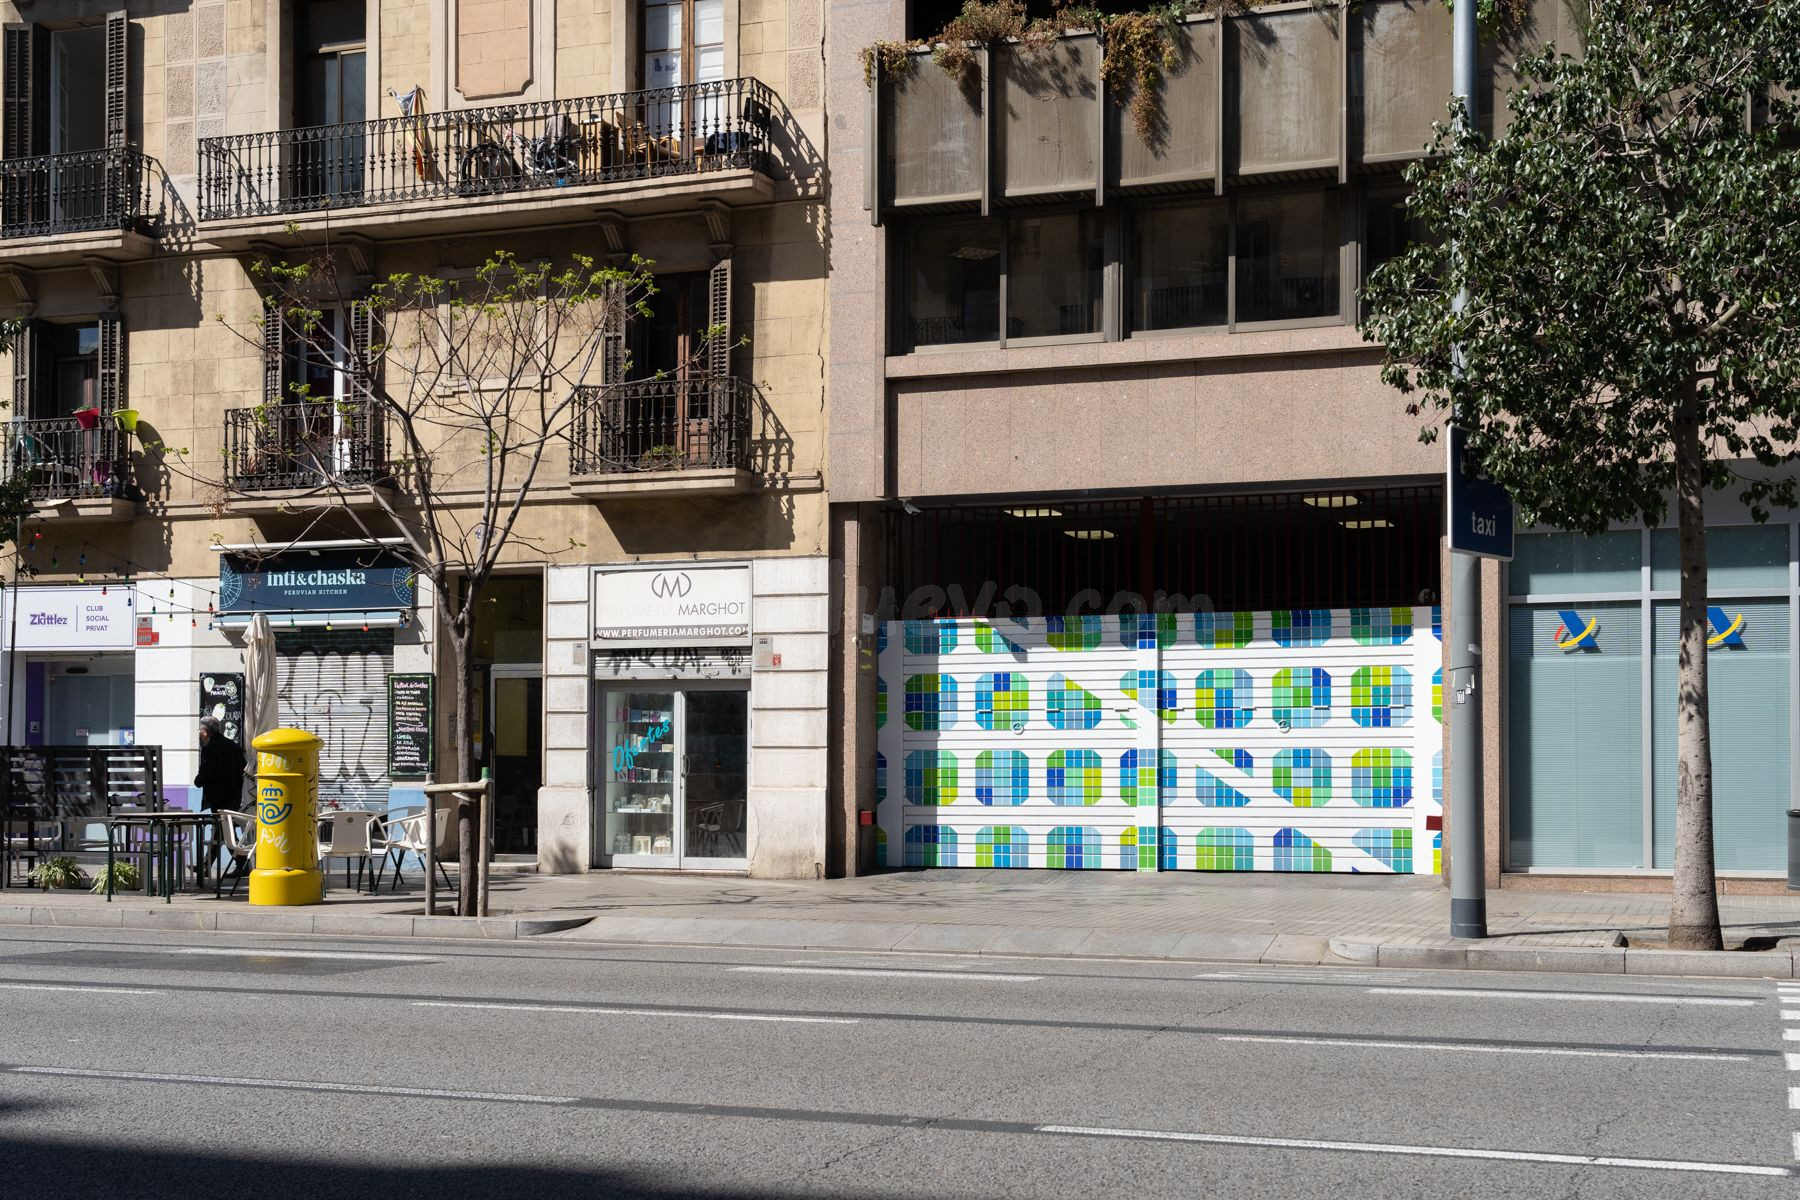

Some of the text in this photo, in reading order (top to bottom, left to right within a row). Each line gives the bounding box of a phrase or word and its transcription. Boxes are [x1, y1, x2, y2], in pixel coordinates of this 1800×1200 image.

[1471, 511, 1496, 537] taxi
[266, 569, 367, 587] inti&chaska
[318, 588, 348, 596] KITCHEN
[677, 602, 746, 616] MARGHOT
[29, 612, 68, 626] Zkittlez
